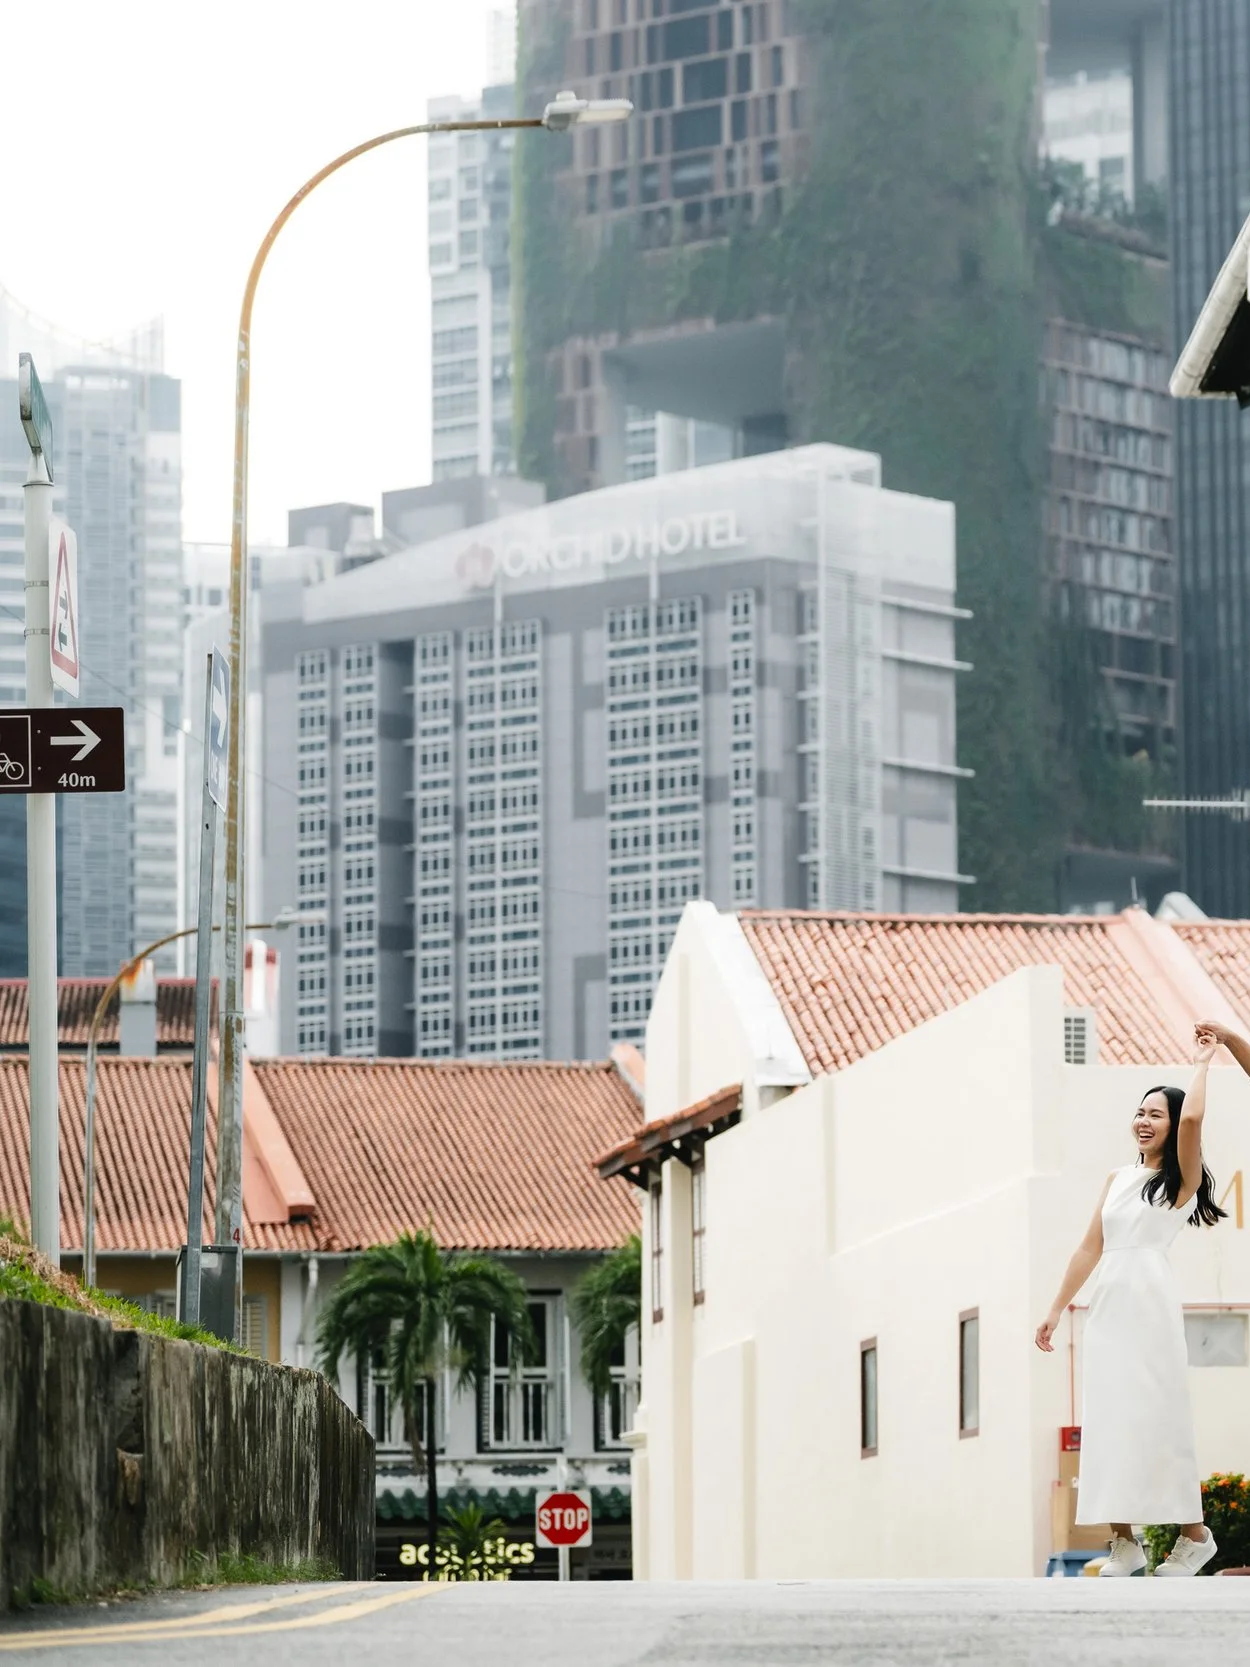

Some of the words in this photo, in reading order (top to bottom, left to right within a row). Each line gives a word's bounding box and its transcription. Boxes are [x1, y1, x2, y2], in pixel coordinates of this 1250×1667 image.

[501, 526, 630, 578] ORCHID
[635, 509, 747, 560] HOTEL
[57, 772, 96, 788] 40m
[538, 1507, 588, 1530] STOP
